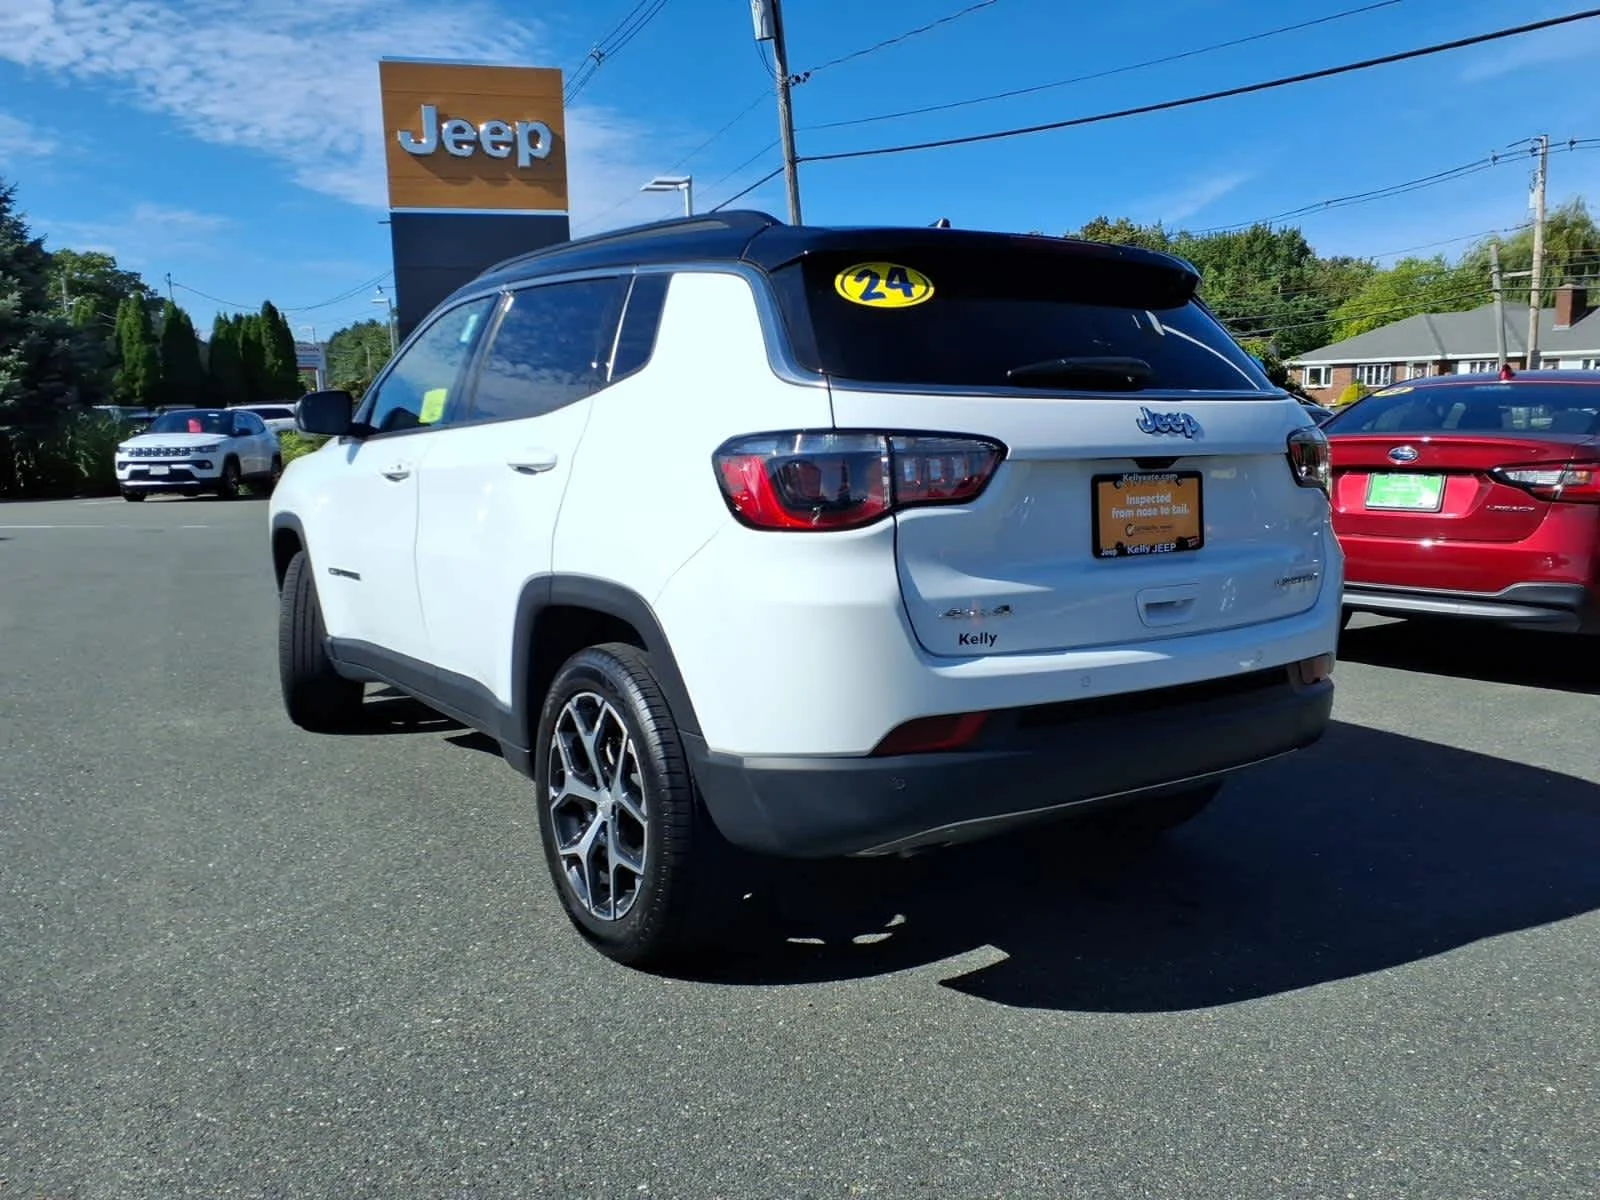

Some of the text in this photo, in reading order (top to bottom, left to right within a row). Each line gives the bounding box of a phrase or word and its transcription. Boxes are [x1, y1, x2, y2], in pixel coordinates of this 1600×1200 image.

[397, 104, 553, 168] Jeep
[854, 267, 915, 301] 24
[1136, 407, 1203, 438] Jeep
[1126, 493, 1172, 506] Inspected
[1111, 504, 1190, 519] from nose to tail.
[1127, 543, 1177, 554] Kelly JEEP
[959, 632, 998, 648] Kelly
